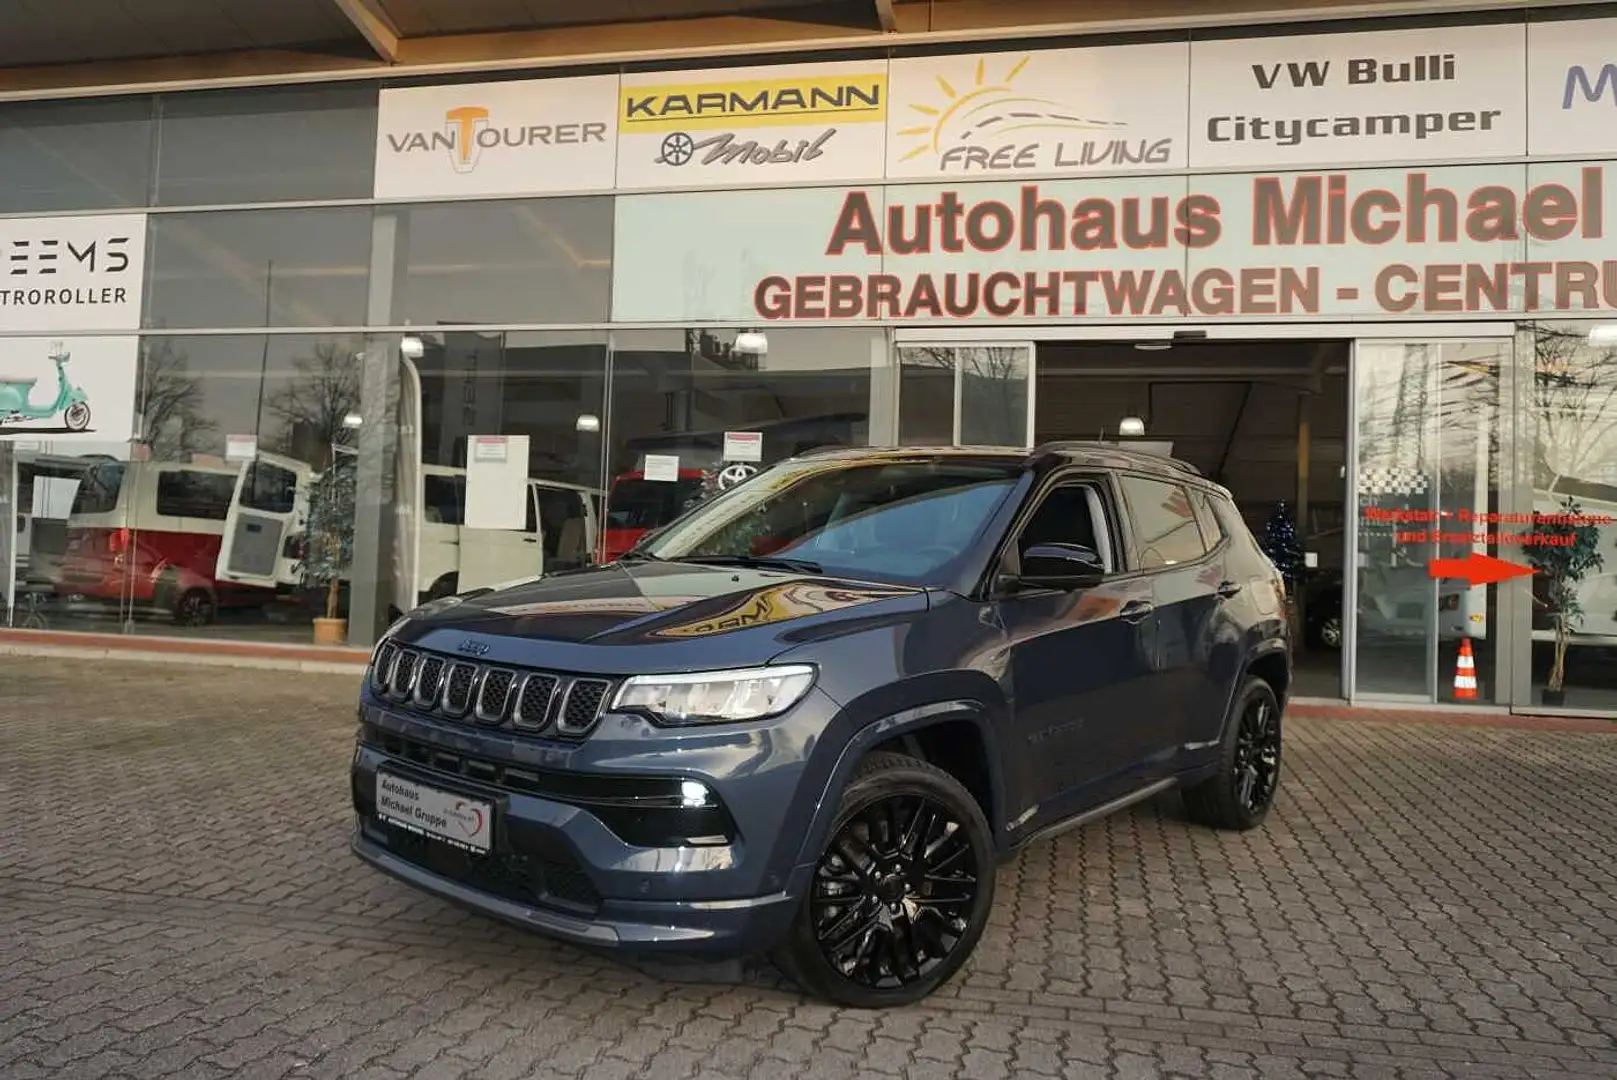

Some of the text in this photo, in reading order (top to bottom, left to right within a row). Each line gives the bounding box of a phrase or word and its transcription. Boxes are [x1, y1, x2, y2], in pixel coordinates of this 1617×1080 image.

[1251, 53, 1456, 89] VW Bulli
[626, 83, 880, 118] KARMANN
[1206, 108, 1502, 146] Citycamper
[688, 127, 838, 166] Mobil
[940, 138, 1173, 171] FREE LIVING
[824, 167, 1604, 256] Autohaus Michael
[0, 287, 127, 306] TROROLLER
[753, 265, 1321, 321] GEBRAUCHTWAGEN
[381, 795, 413, 816] Michael
[415, 805, 447, 828] Gruppe
